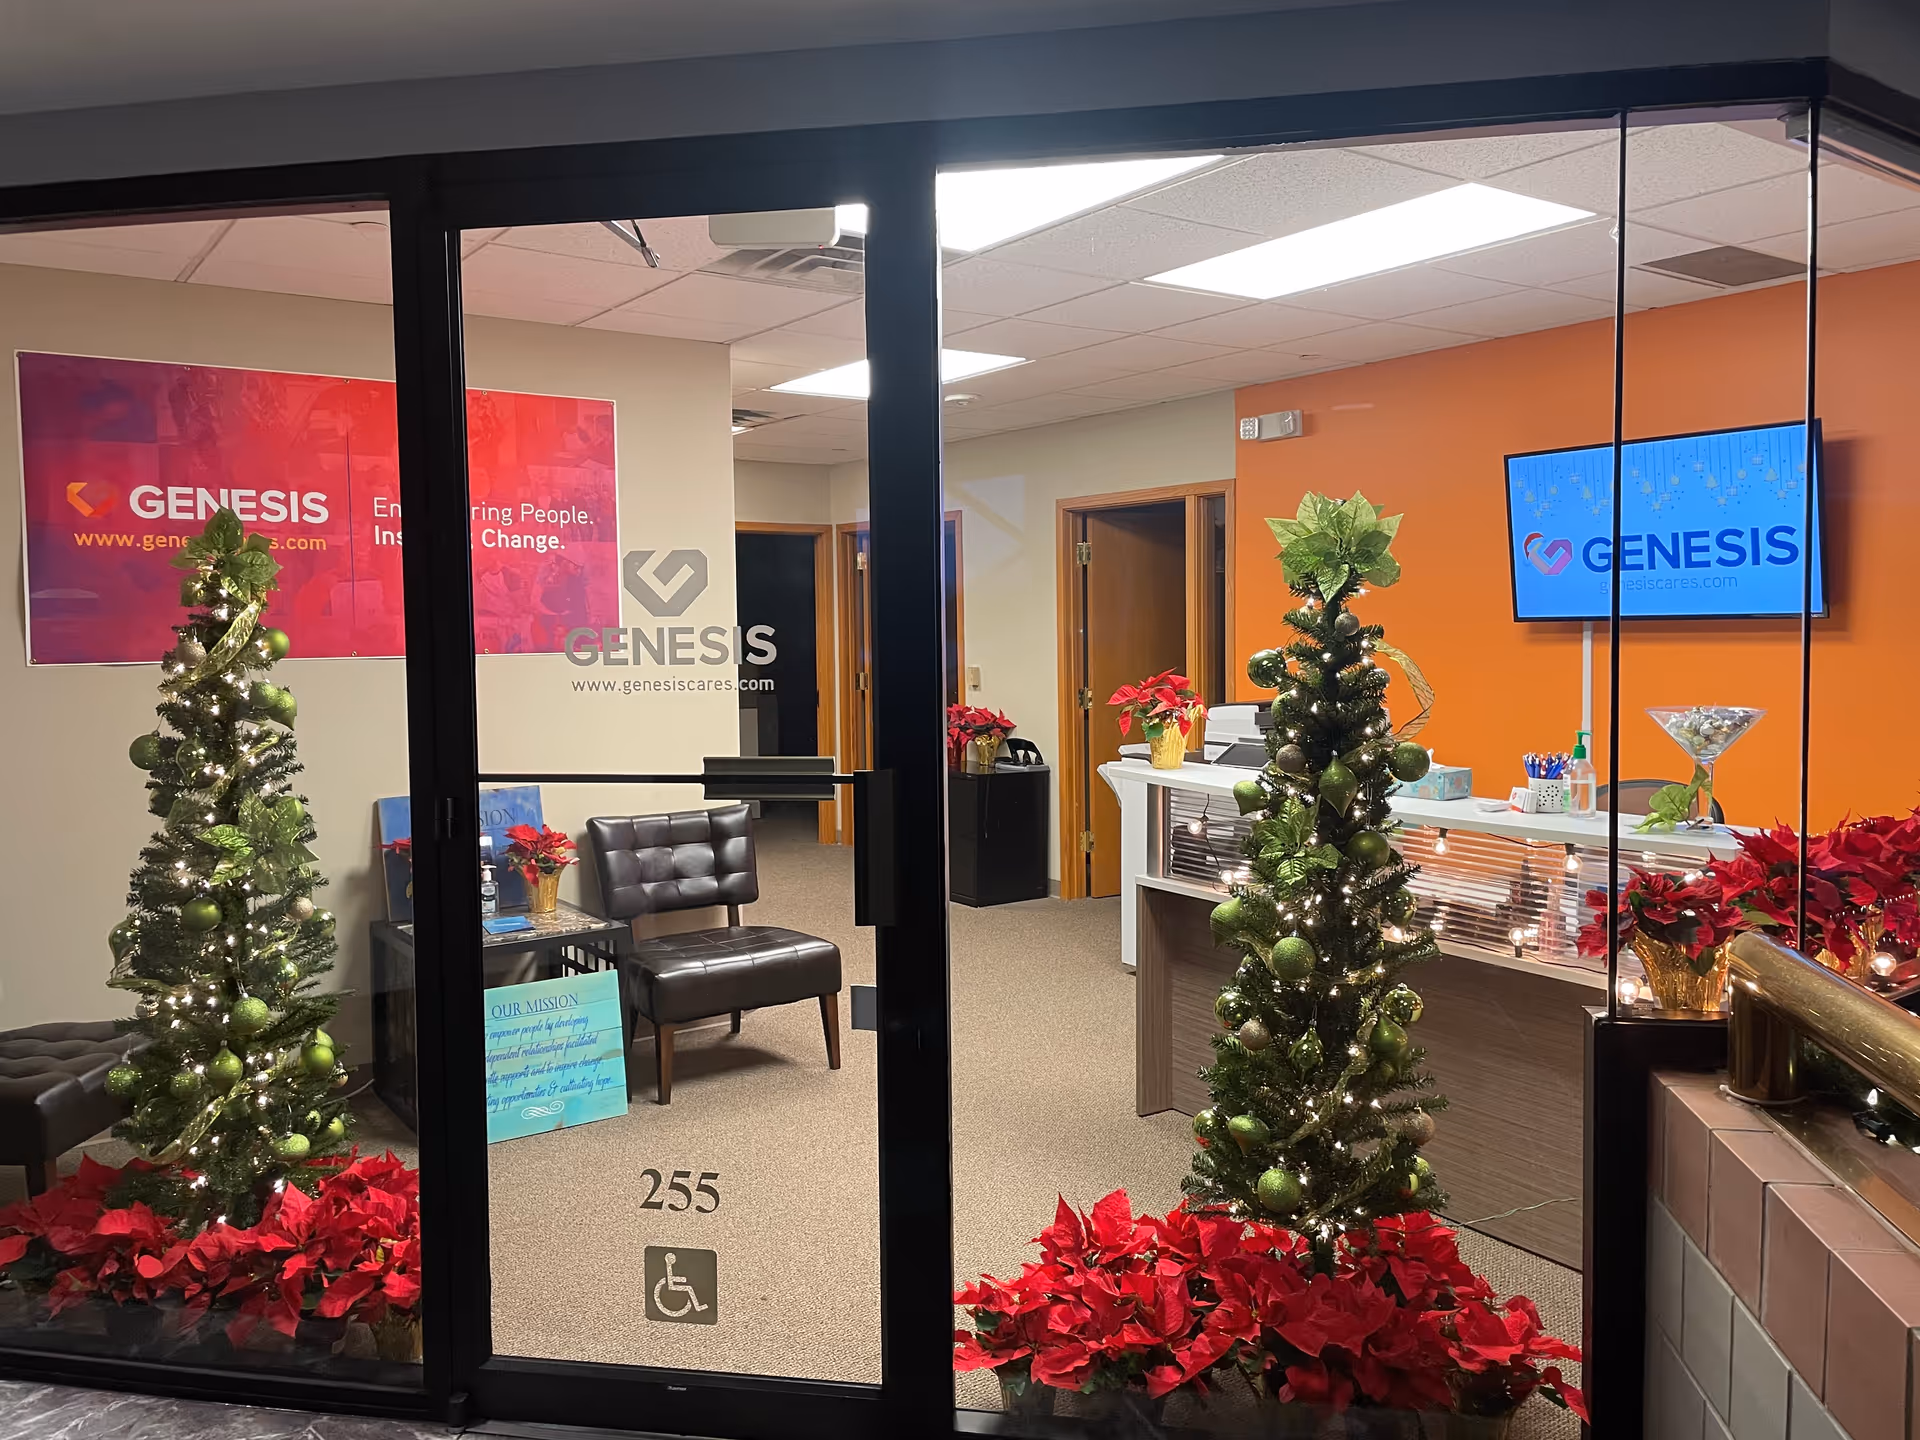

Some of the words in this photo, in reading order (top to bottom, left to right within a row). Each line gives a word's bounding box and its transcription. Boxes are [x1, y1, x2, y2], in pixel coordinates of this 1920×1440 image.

[129, 484, 329, 524] GENESIS
[520, 503, 594, 528] People.
[74, 532, 327, 551] www.genes.com
[481, 528, 565, 553] Change.
[1582, 525, 1799, 573] GENESIS
[564, 624, 778, 667] GENESIS
[571, 676, 775, 695] www.genesiscares.com
[491, 1002, 521, 1019] OUR
[526, 993, 579, 1014] MISSION
[489, 1028, 521, 1046] empower
[519, 1020, 544, 1041] people
[545, 1018, 555, 1037] by
[554, 1014, 589, 1035] developing
[486, 1046, 522, 1069] dependent
[521, 1039, 564, 1059] relationships
[564, 1032, 600, 1058] facilitated
[500, 1065, 529, 1088] supports
[530, 1060, 546, 1077] and
[546, 1062, 554, 1074] to
[554, 1060, 578, 1078] inspire
[501, 1085, 546, 1110] opportunities
[559, 1076, 594, 1096] cultivating
[639, 1168, 720, 1214] 255
